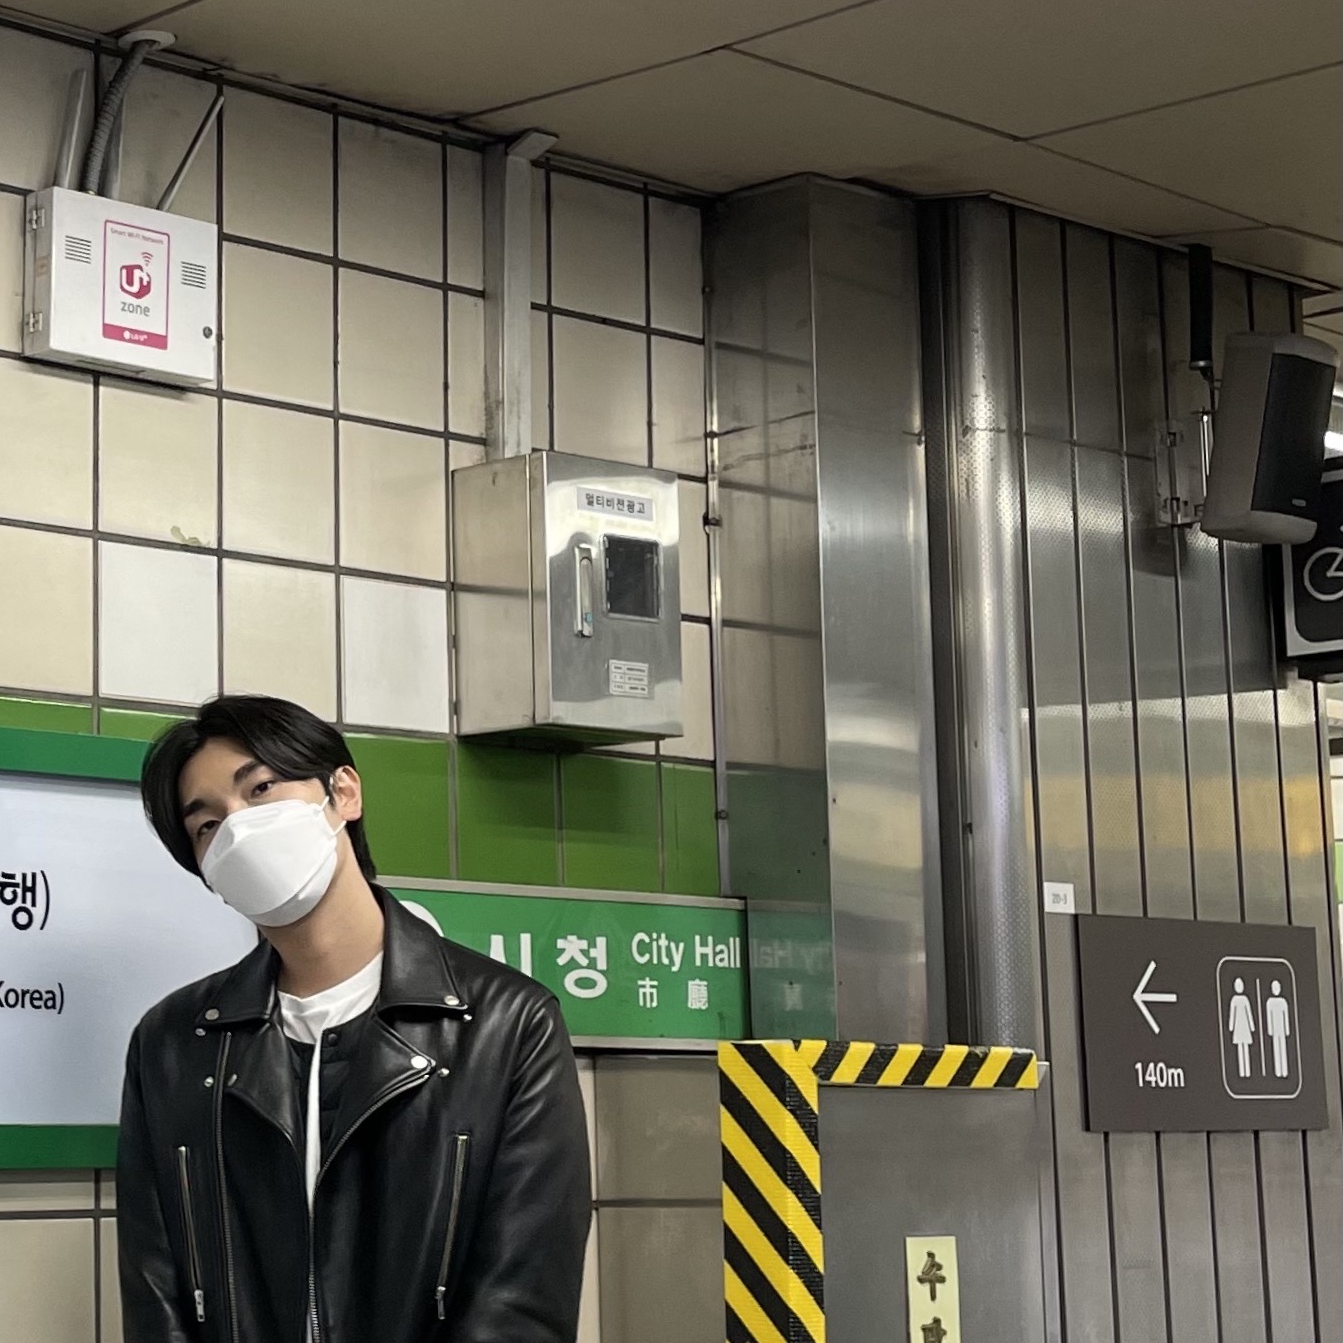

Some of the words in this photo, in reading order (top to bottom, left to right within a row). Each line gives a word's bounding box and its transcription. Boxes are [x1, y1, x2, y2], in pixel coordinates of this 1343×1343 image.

[120, 301, 151, 317] zone
[556, 934, 608, 999] 청
[631, 931, 685, 972] City
[694, 934, 741, 969] Hall
[1134, 1061, 1185, 1088] 140m
